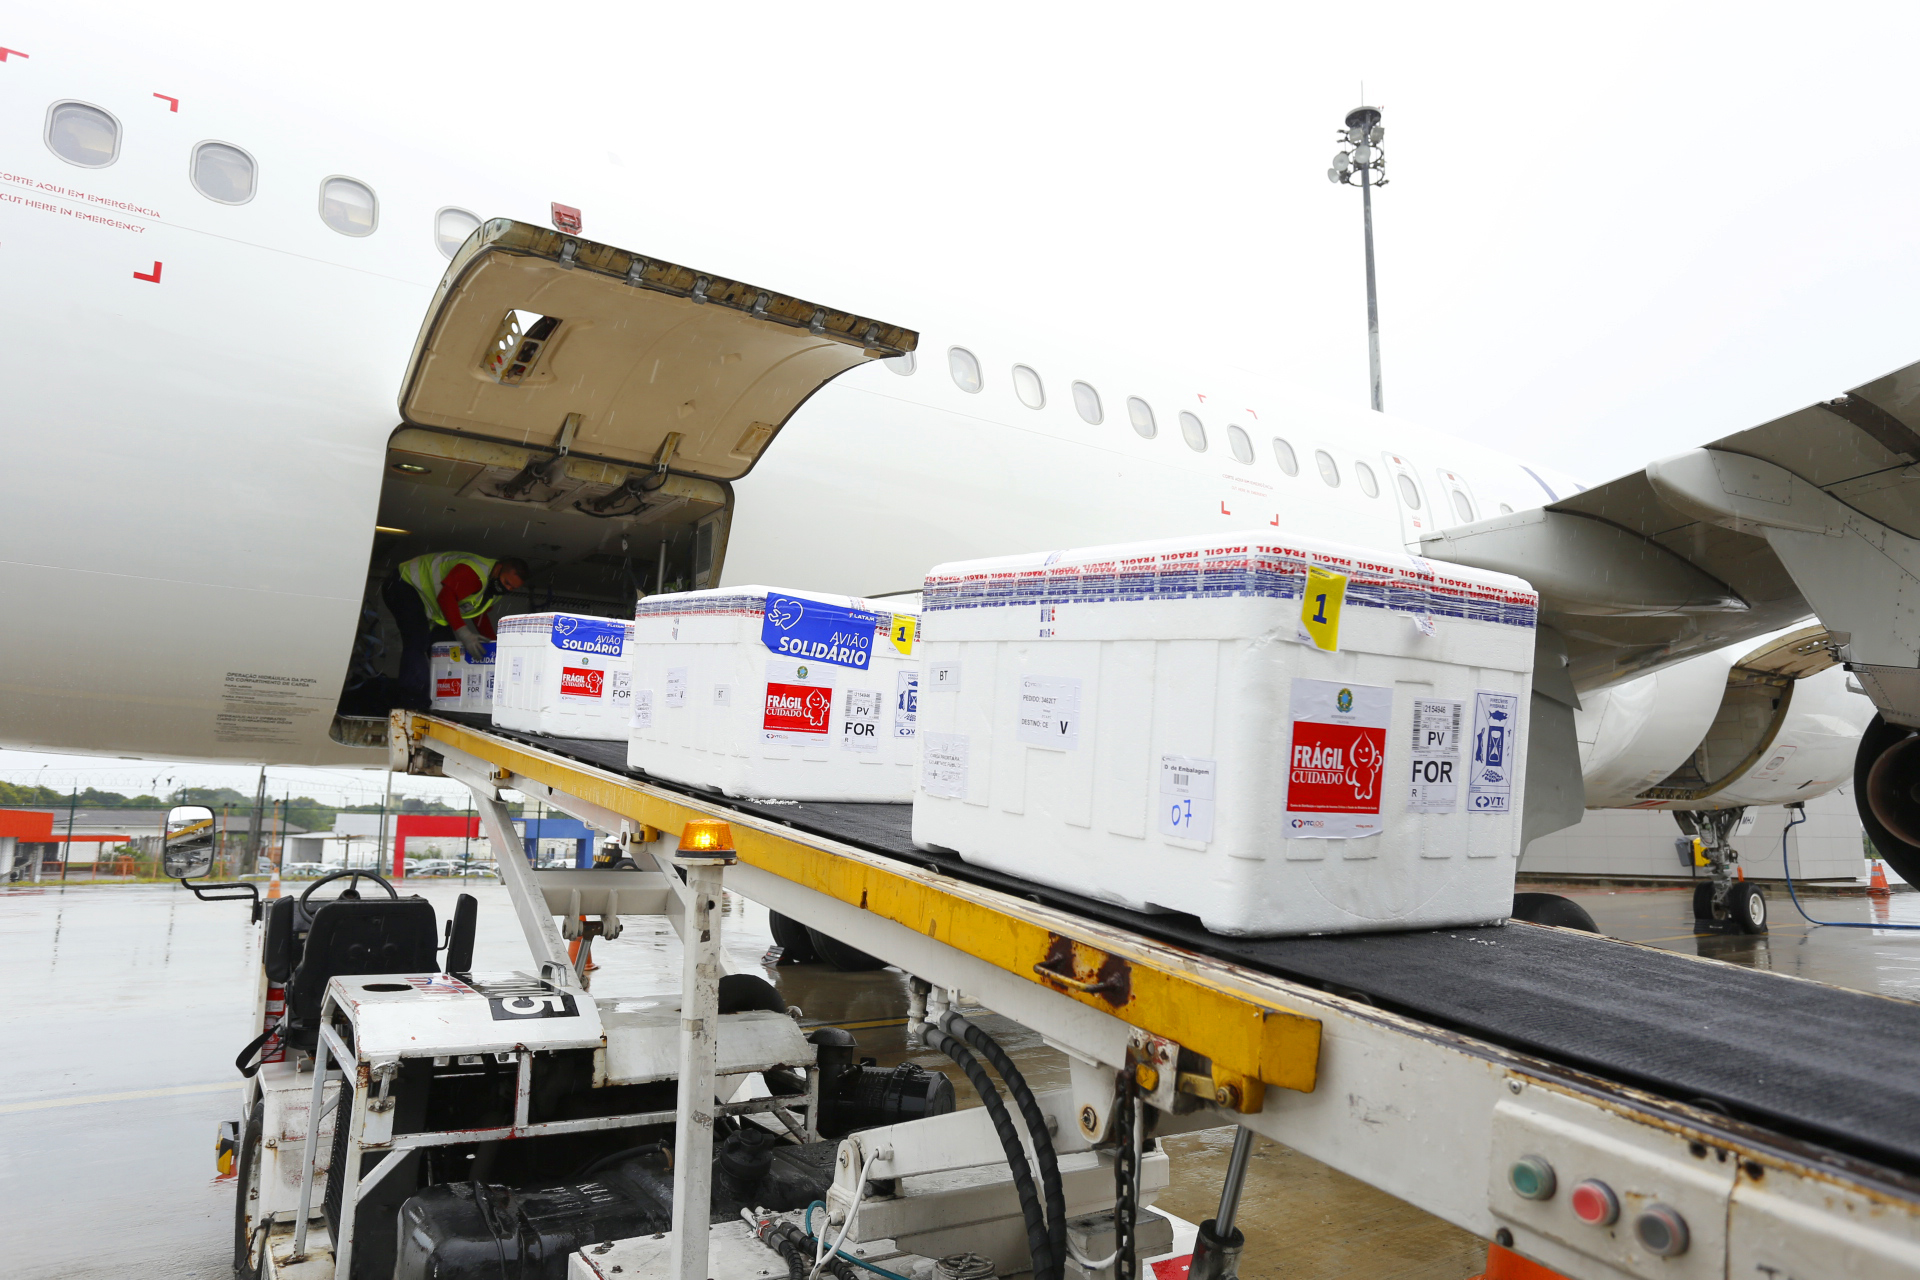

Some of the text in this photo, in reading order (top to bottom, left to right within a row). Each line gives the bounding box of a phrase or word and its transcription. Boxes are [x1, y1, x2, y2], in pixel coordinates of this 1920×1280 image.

[0, 172, 161, 218] CORTE AQUI EM EMERGÊNCIA
[0, 193, 146, 233] CUT HERE IN EMERGENCY
[1256, 546, 1306, 559] FRÁGIL
[1312, 594, 1327, 624] 1
[854, 613, 875, 621] LATAM
[595, 634, 621, 645] AVIÃO
[830, 631, 869, 649] AVIÃO
[897, 626, 906, 642] 1
[561, 638, 620, 655] SOLIDÁRIO
[778, 636, 867, 666] SOLIDÁRIO
[562, 672, 586, 683] FRÁGIL
[939, 670, 948, 681] BT
[561, 680, 585, 688] CUIDADO
[613, 689, 631, 698] FOR
[767, 693, 802, 709] FRÁGIL
[766, 708, 802, 717] CUIDADO
[856, 706, 870, 716] PV
[845, 721, 875, 736] FOR
[1060, 720, 1068, 735] V
[1428, 731, 1445, 746] PV
[1293, 741, 1344, 770] FRÁGIL
[1178, 766, 1210, 775] Embalagem
[1291, 770, 1343, 785] CUIDADO
[1412, 760, 1453, 783] FOR
[1411, 788, 1417, 797] R
[1171, 799, 1192, 828] 07
[1742, 816, 1755, 825] MHJ
